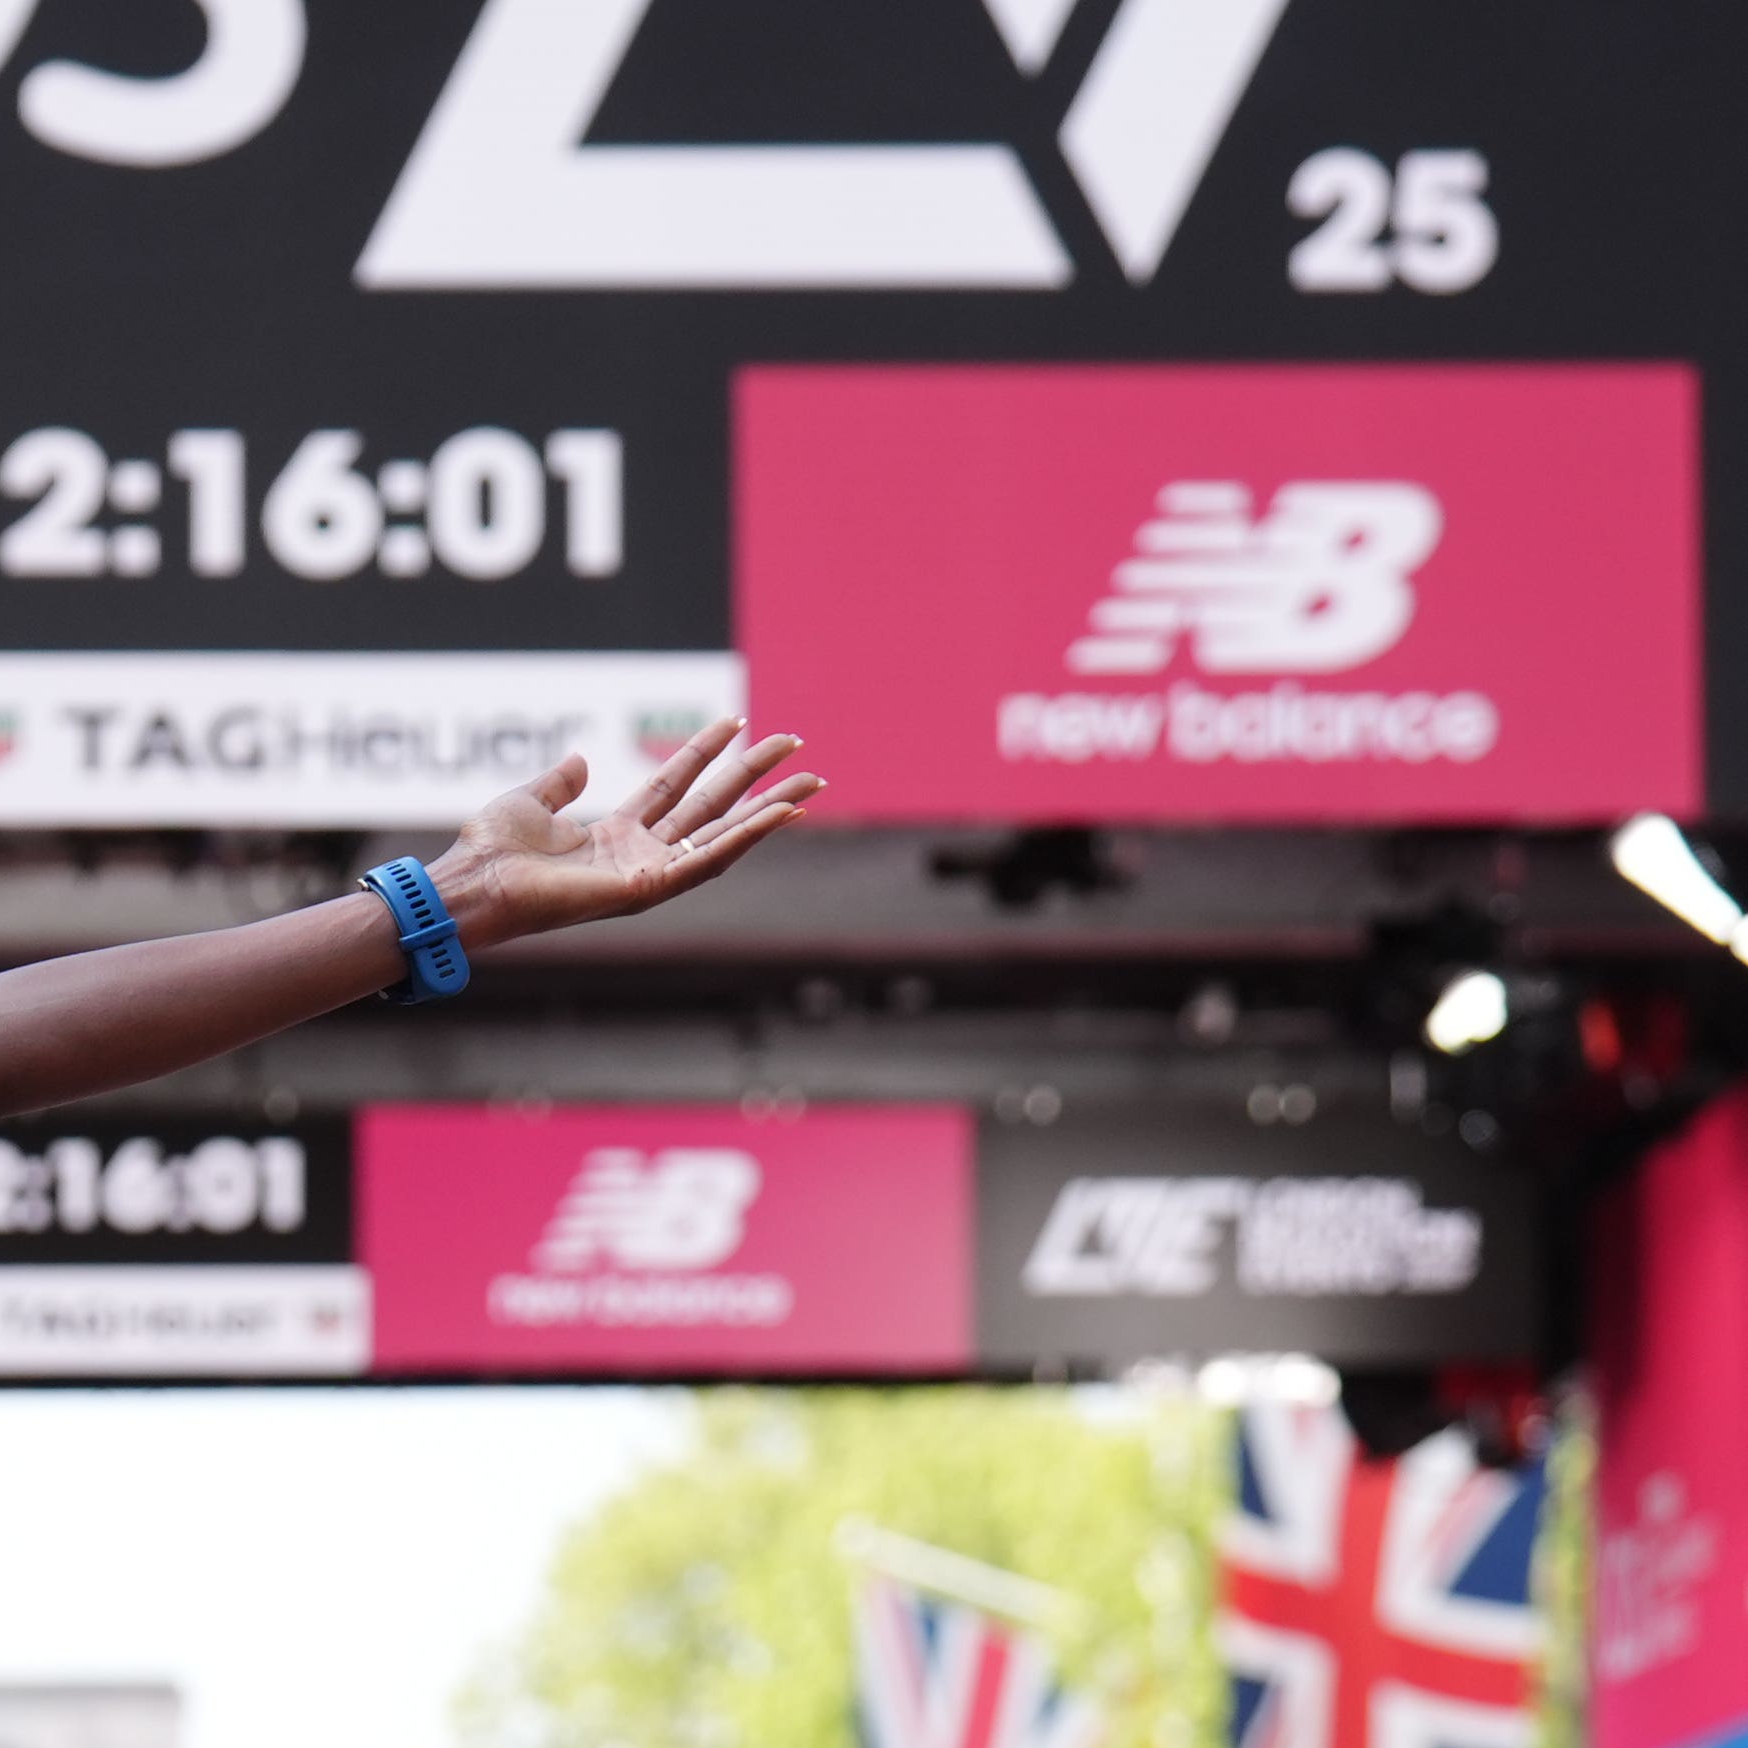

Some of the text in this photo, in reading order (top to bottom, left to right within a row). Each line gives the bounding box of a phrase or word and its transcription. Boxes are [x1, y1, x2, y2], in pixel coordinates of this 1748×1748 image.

[1285, 147, 1500, 295] 25
[995, 680, 1500, 765] new balance
